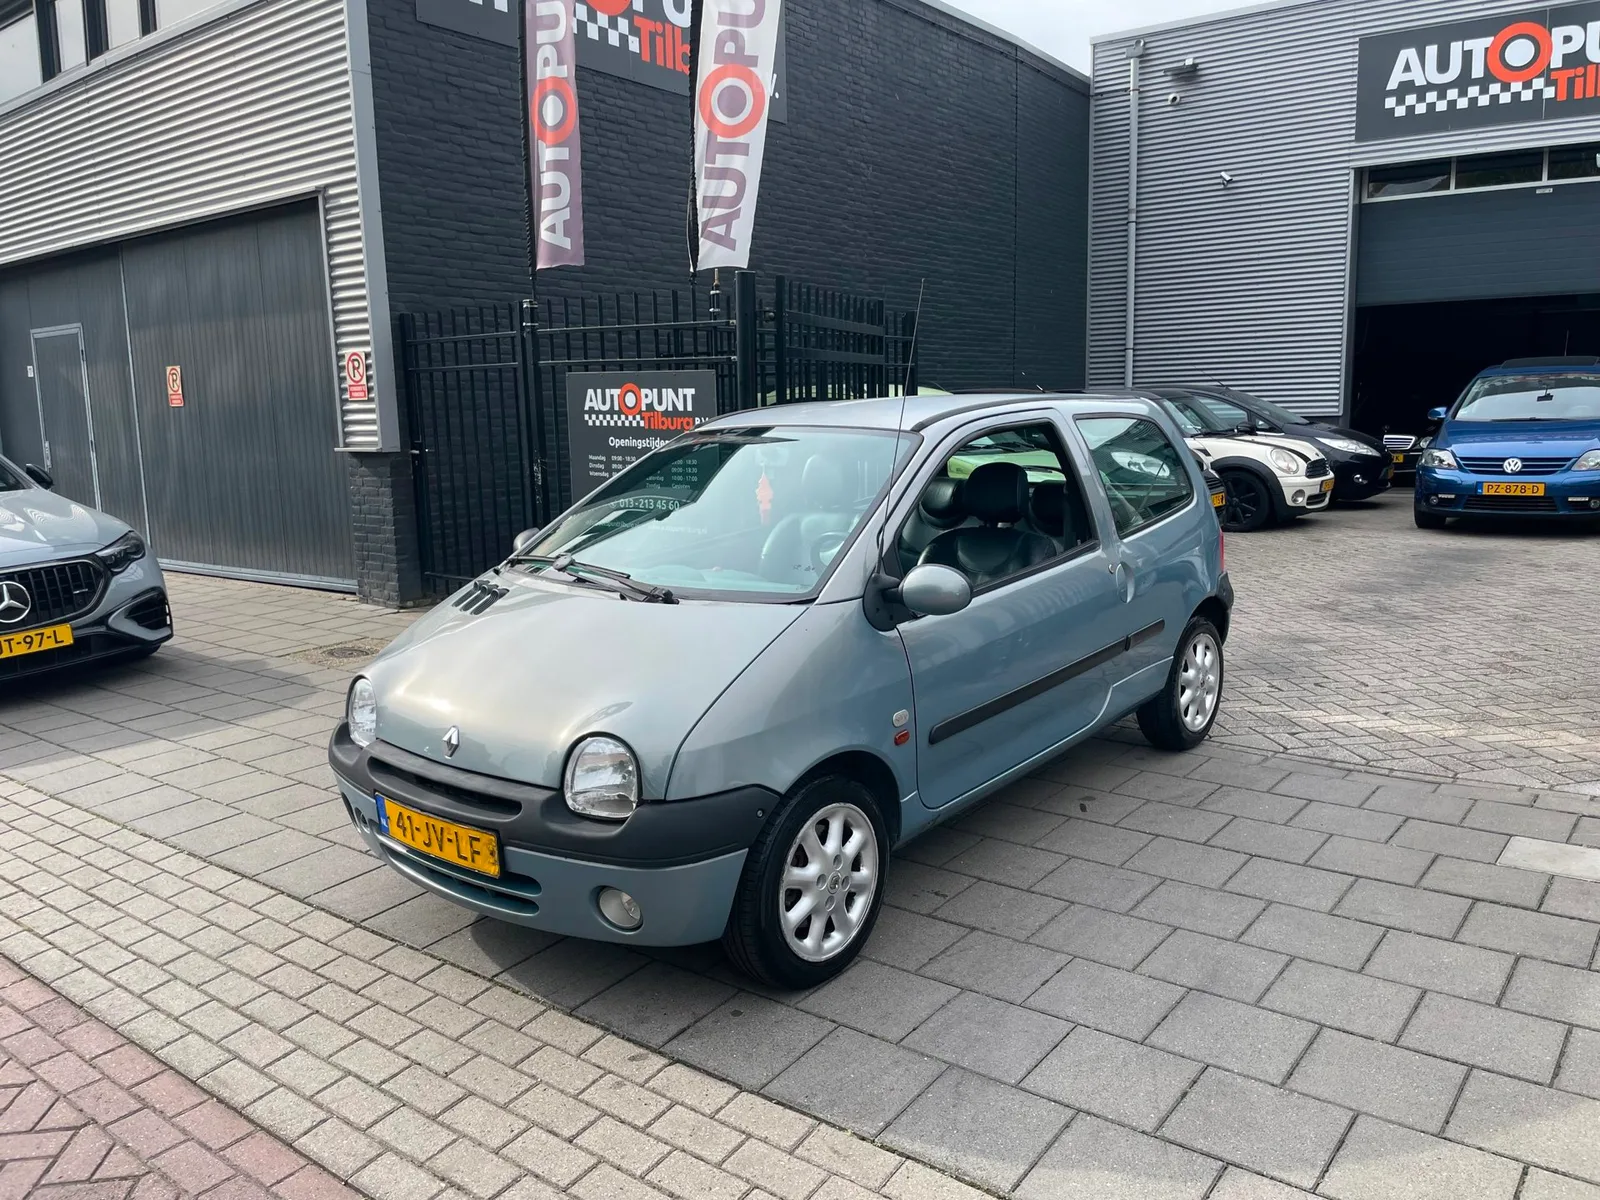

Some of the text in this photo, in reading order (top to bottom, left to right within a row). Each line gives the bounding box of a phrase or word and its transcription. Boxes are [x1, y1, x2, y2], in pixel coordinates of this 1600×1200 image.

[584, 382, 696, 416] AUTOPUNT
[641, 411, 693, 433] Tilburg
[1486, 484, 1540, 495] PZ-878-D
[656, 499, 667, 510] 45
[668, 500, 680, 511] 60
[396, 811, 481, 864] 41-JV-LF
